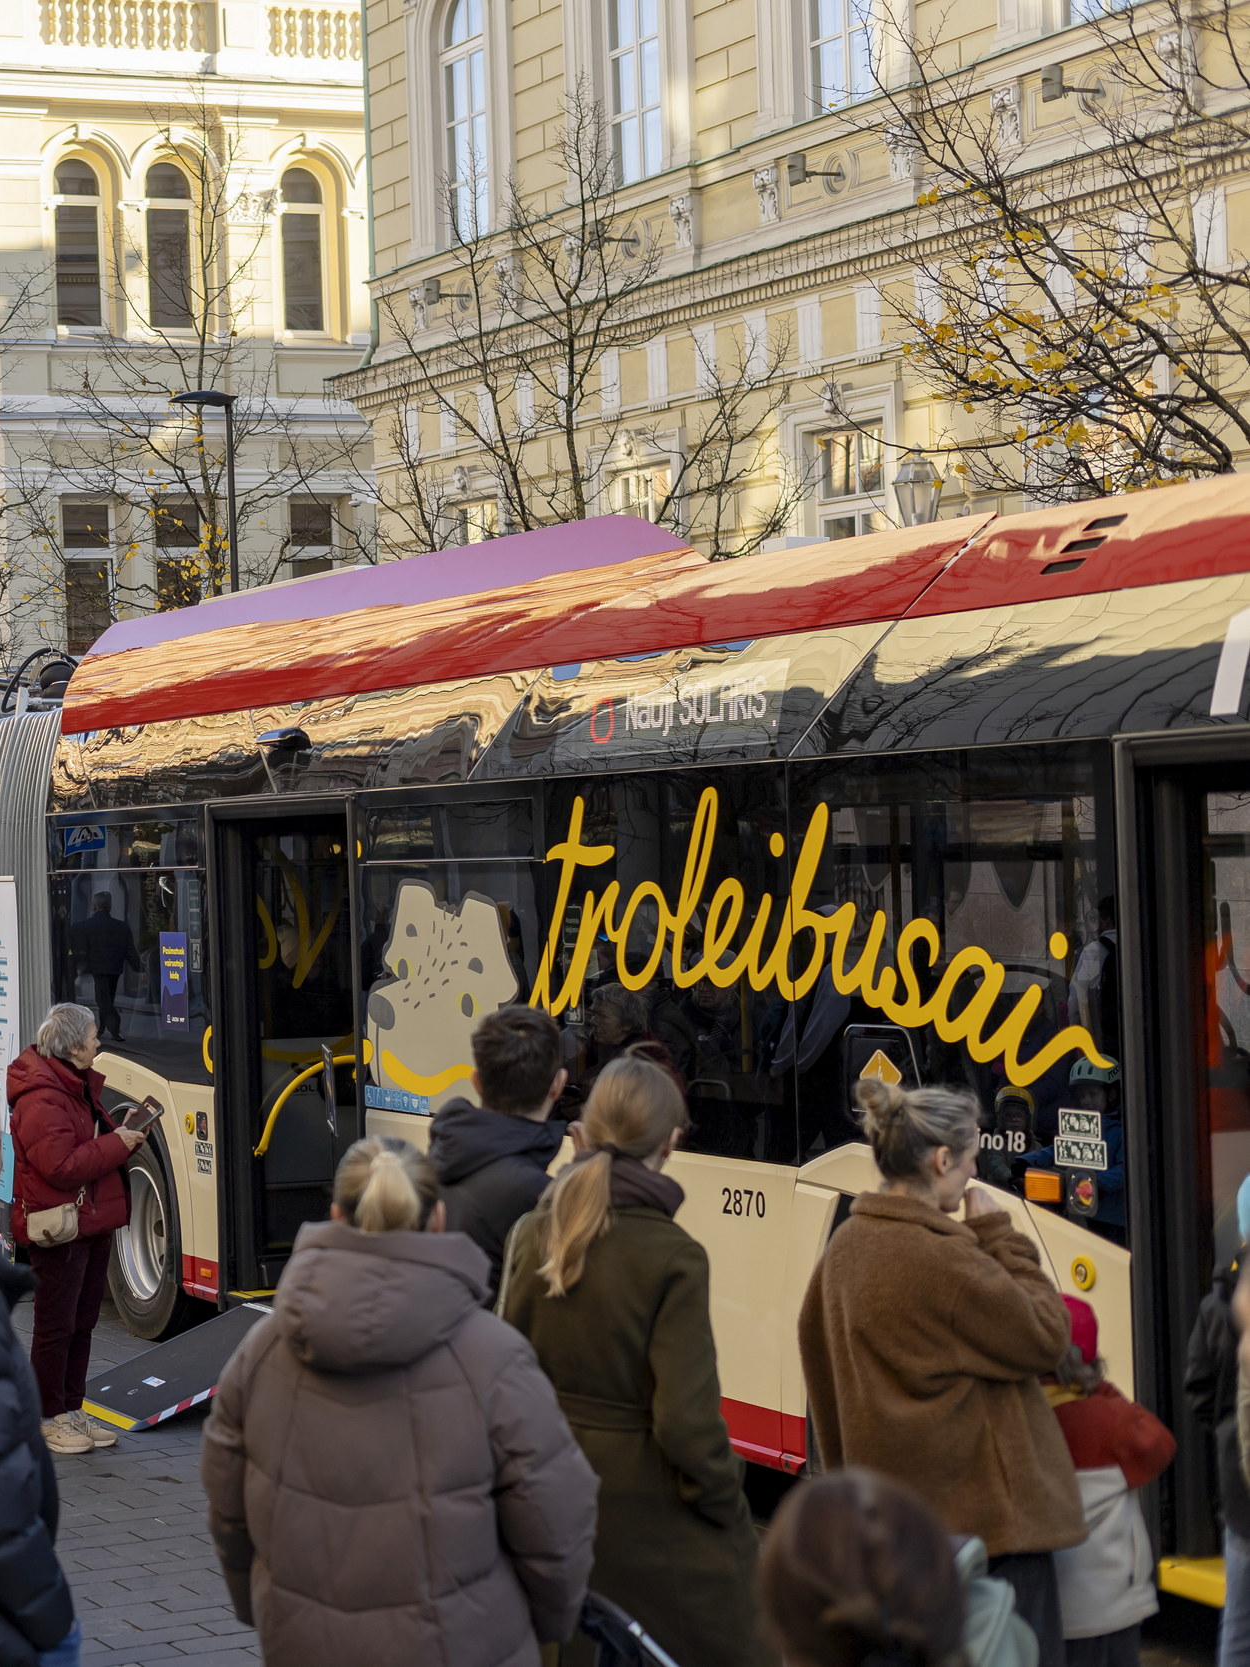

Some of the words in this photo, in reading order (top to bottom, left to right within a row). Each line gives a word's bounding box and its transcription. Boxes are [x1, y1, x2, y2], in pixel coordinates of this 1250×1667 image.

[677, 675, 767, 726] SOLARIS
[528, 787, 1115, 1088] troleibusai
[721, 1187, 766, 1219] 2870
